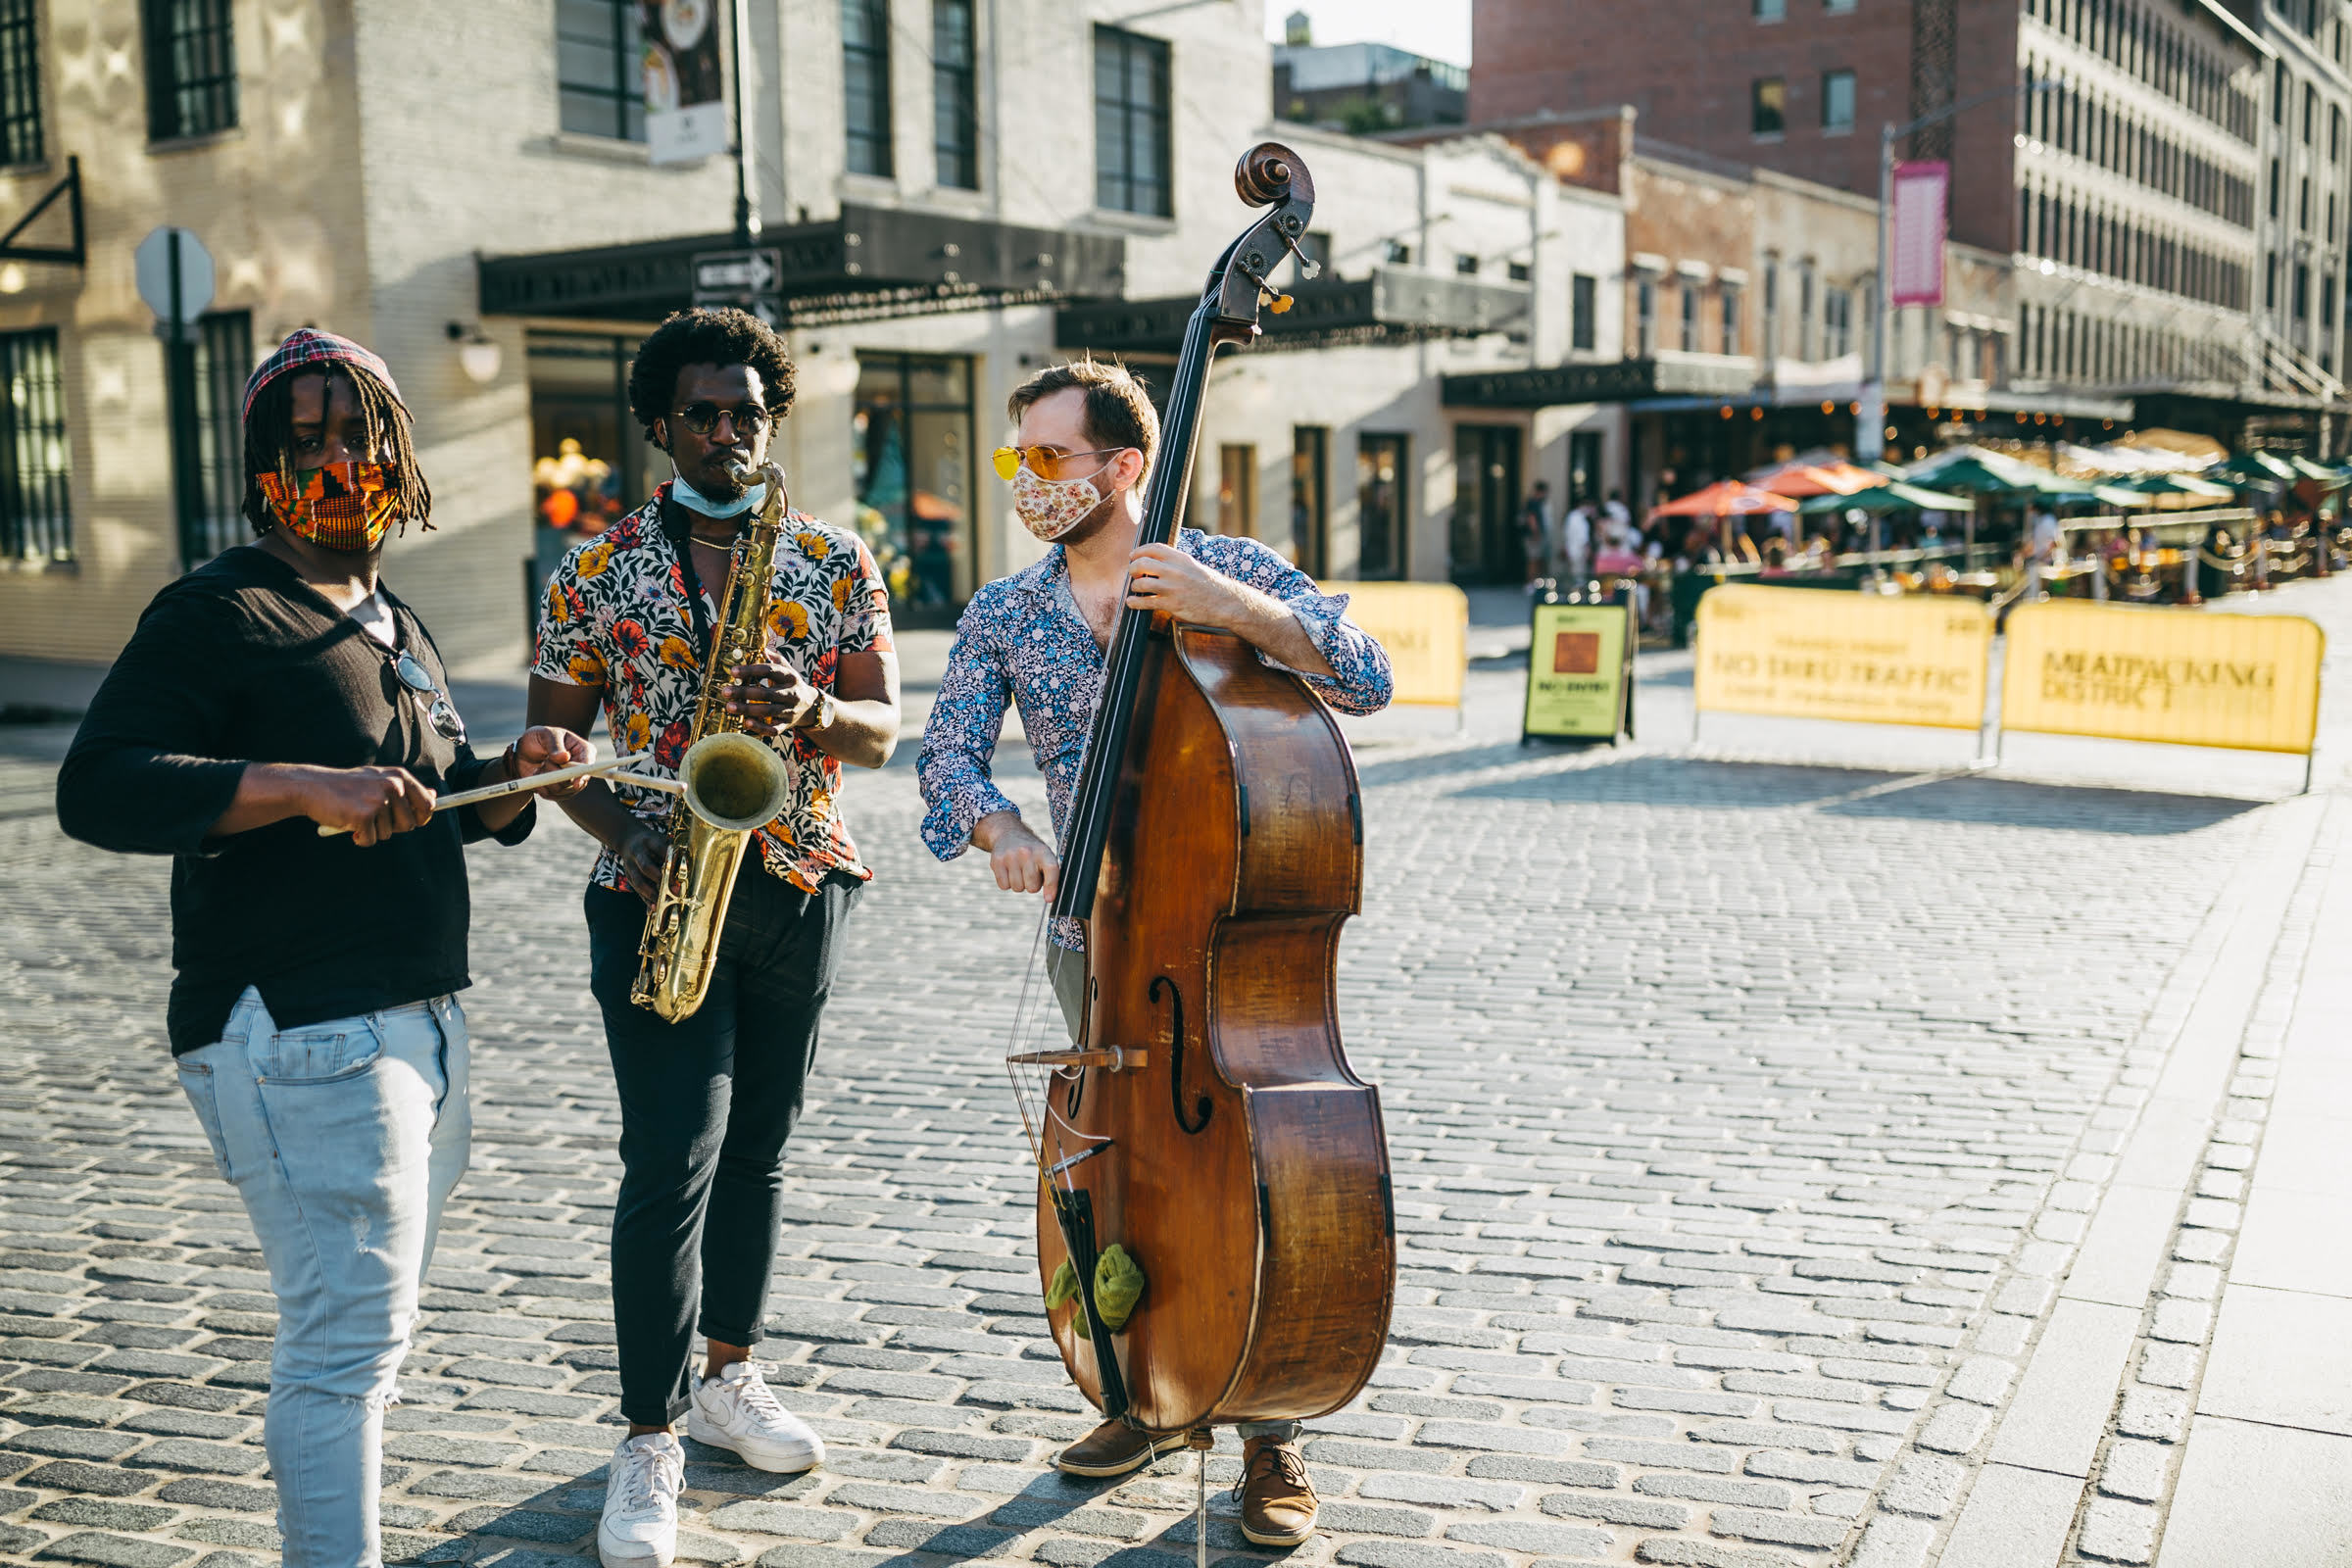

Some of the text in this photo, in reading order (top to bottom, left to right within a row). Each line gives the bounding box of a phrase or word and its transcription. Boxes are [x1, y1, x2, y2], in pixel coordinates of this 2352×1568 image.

[1712, 652, 1971, 695] NO THRU TRAFFIC
[2043, 651, 2276, 688] MEATPACKING
[2042, 678, 2173, 710] DISTRICT
